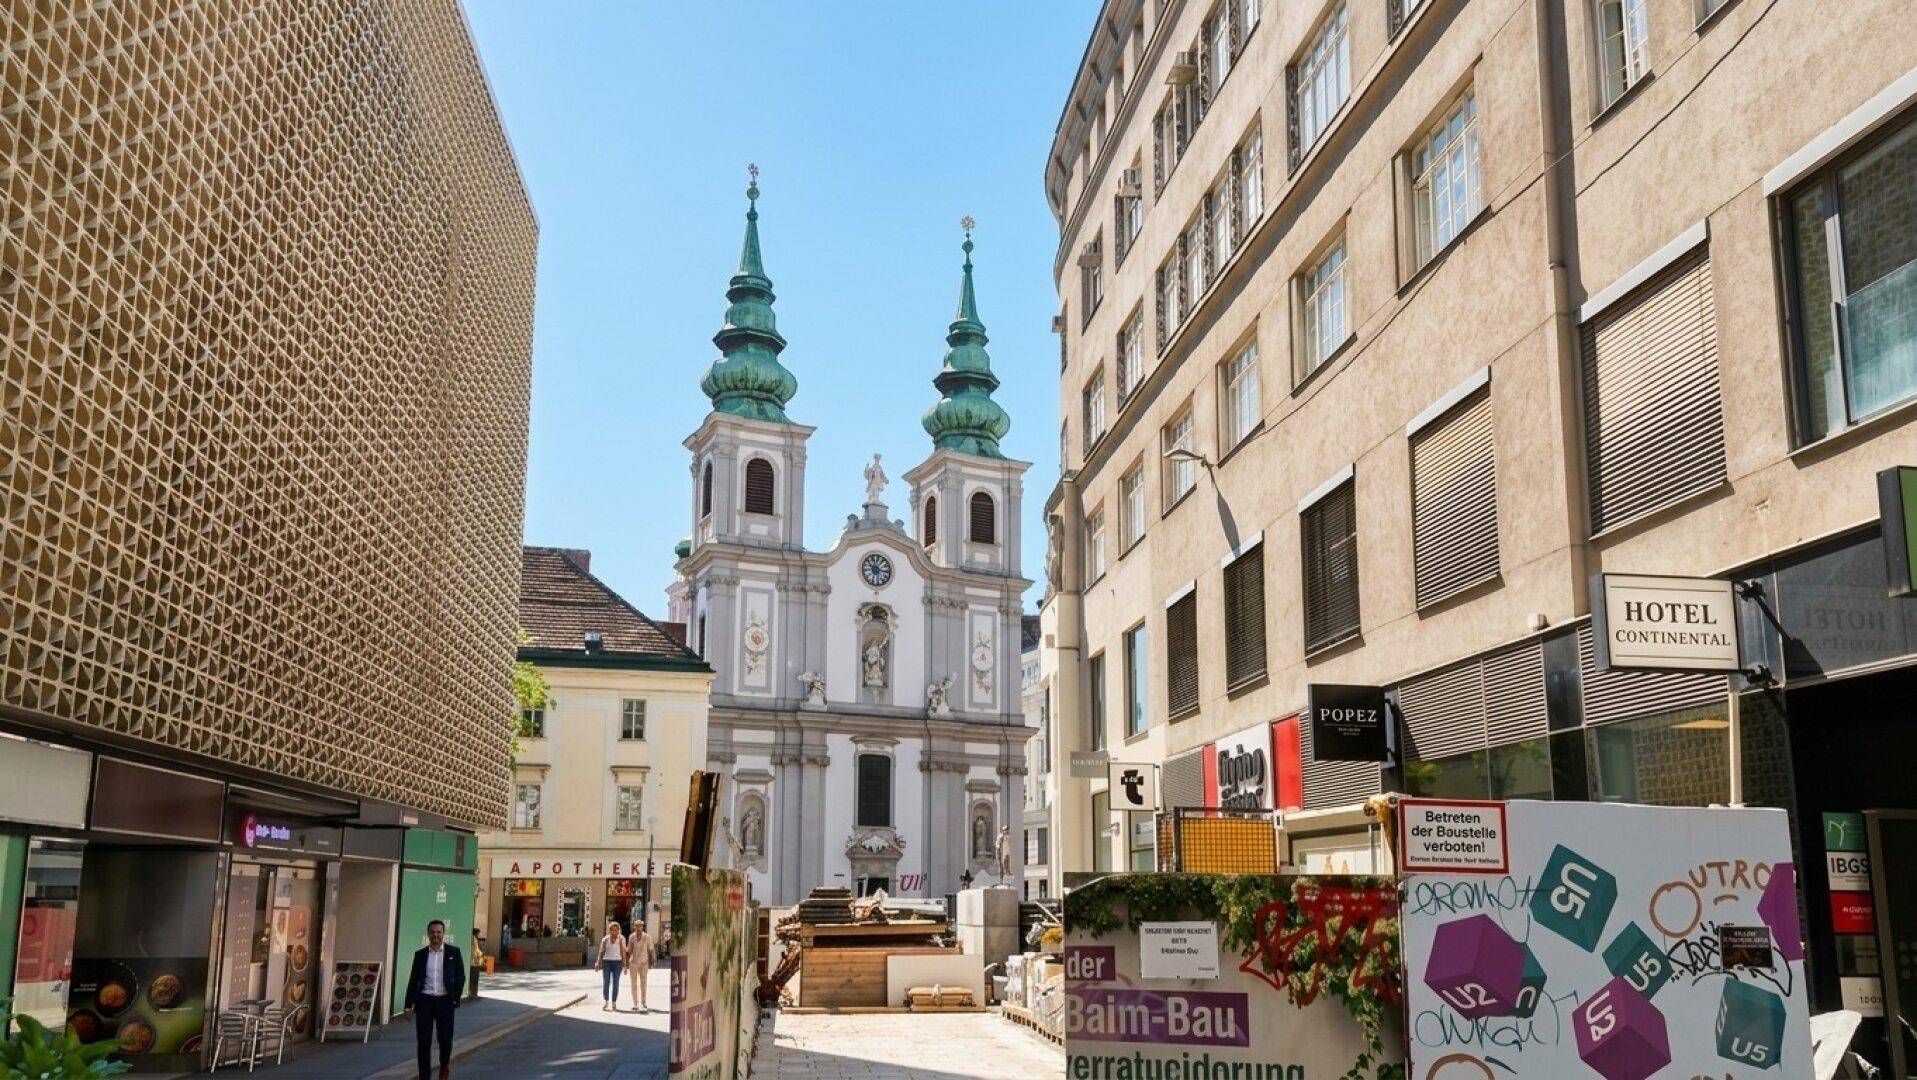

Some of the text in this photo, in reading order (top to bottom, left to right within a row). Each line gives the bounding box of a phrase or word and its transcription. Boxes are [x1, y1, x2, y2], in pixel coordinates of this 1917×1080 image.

[1625, 601, 1717, 624] HOTEL
[1616, 630, 1731, 646] CONTINENTAL
[1320, 708, 1378, 722] POPEZ
[1425, 811, 1480, 824] Betreten
[1411, 825, 1496, 839] der Baustelle
[1424, 841, 1486, 853] verboten!
[1551, 861, 1598, 920] U5
[1067, 950, 1105, 978] der
[1623, 951, 1661, 992] U5
[1441, 982, 1498, 1009] U2
[1731, 1037, 1769, 1062] U5
